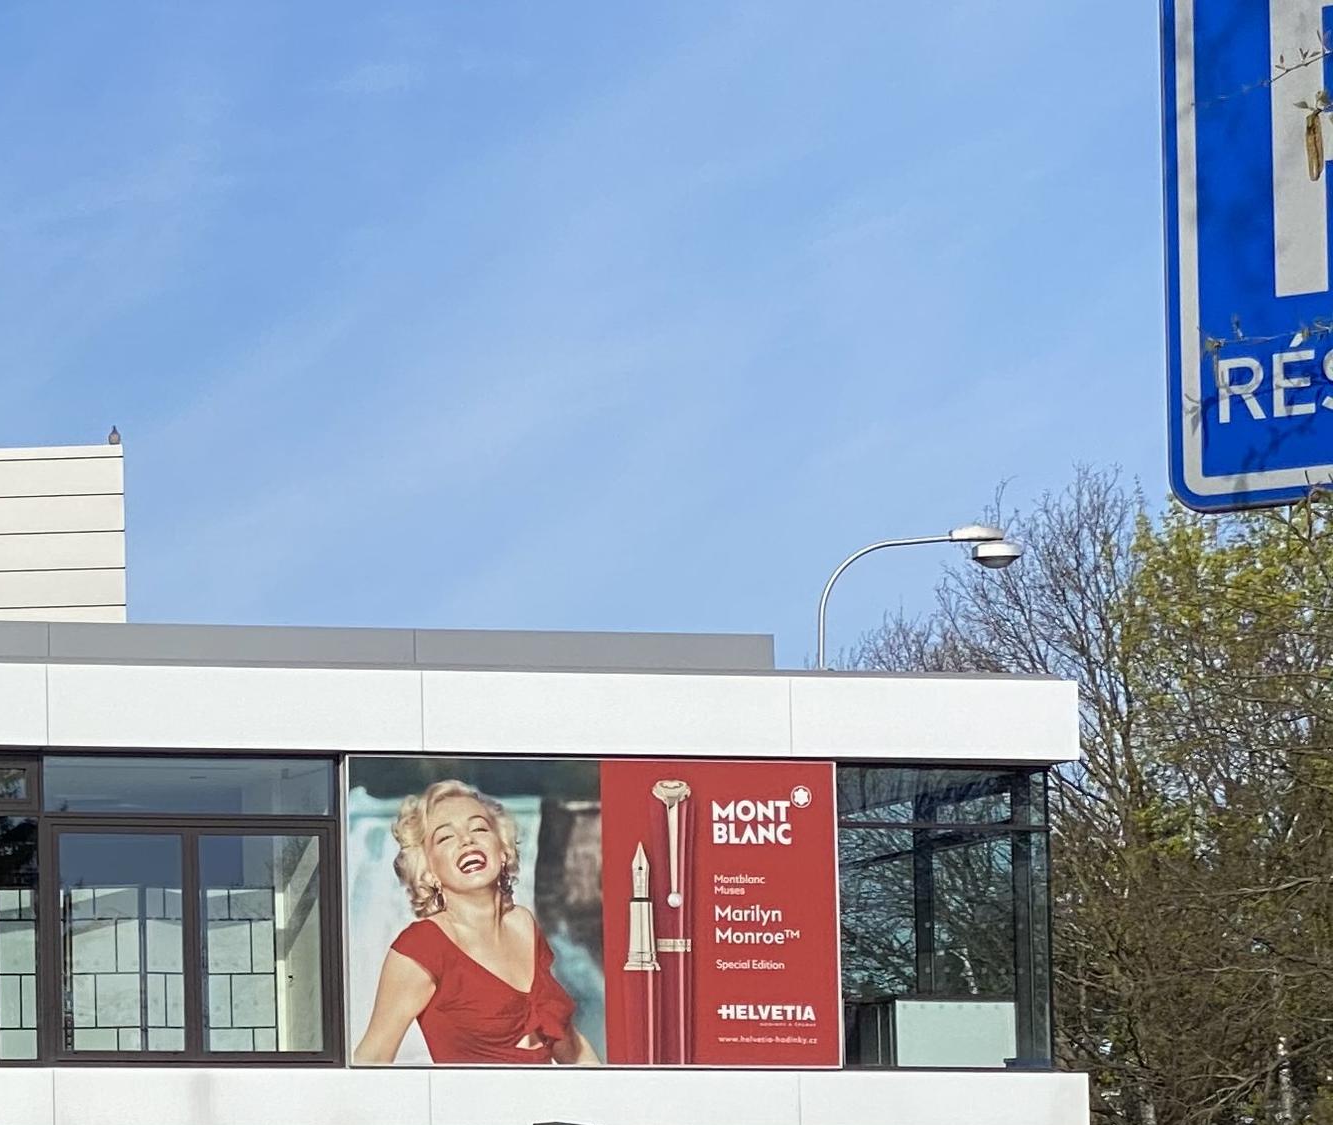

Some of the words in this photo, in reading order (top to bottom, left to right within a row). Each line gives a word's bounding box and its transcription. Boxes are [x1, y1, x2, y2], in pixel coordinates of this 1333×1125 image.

[1218, 333, 1333, 424] RÉ
[711, 800, 791, 822] MONT
[712, 823, 792, 845] BLANC
[714, 874, 766, 885] Montblanc
[714, 885, 746, 896] Muses
[714, 904, 783, 926] Marilyn
[716, 959, 751, 972] Special
[752, 959, 786, 971] Edition
[717, 1004, 817, 1021] HELVETIA
